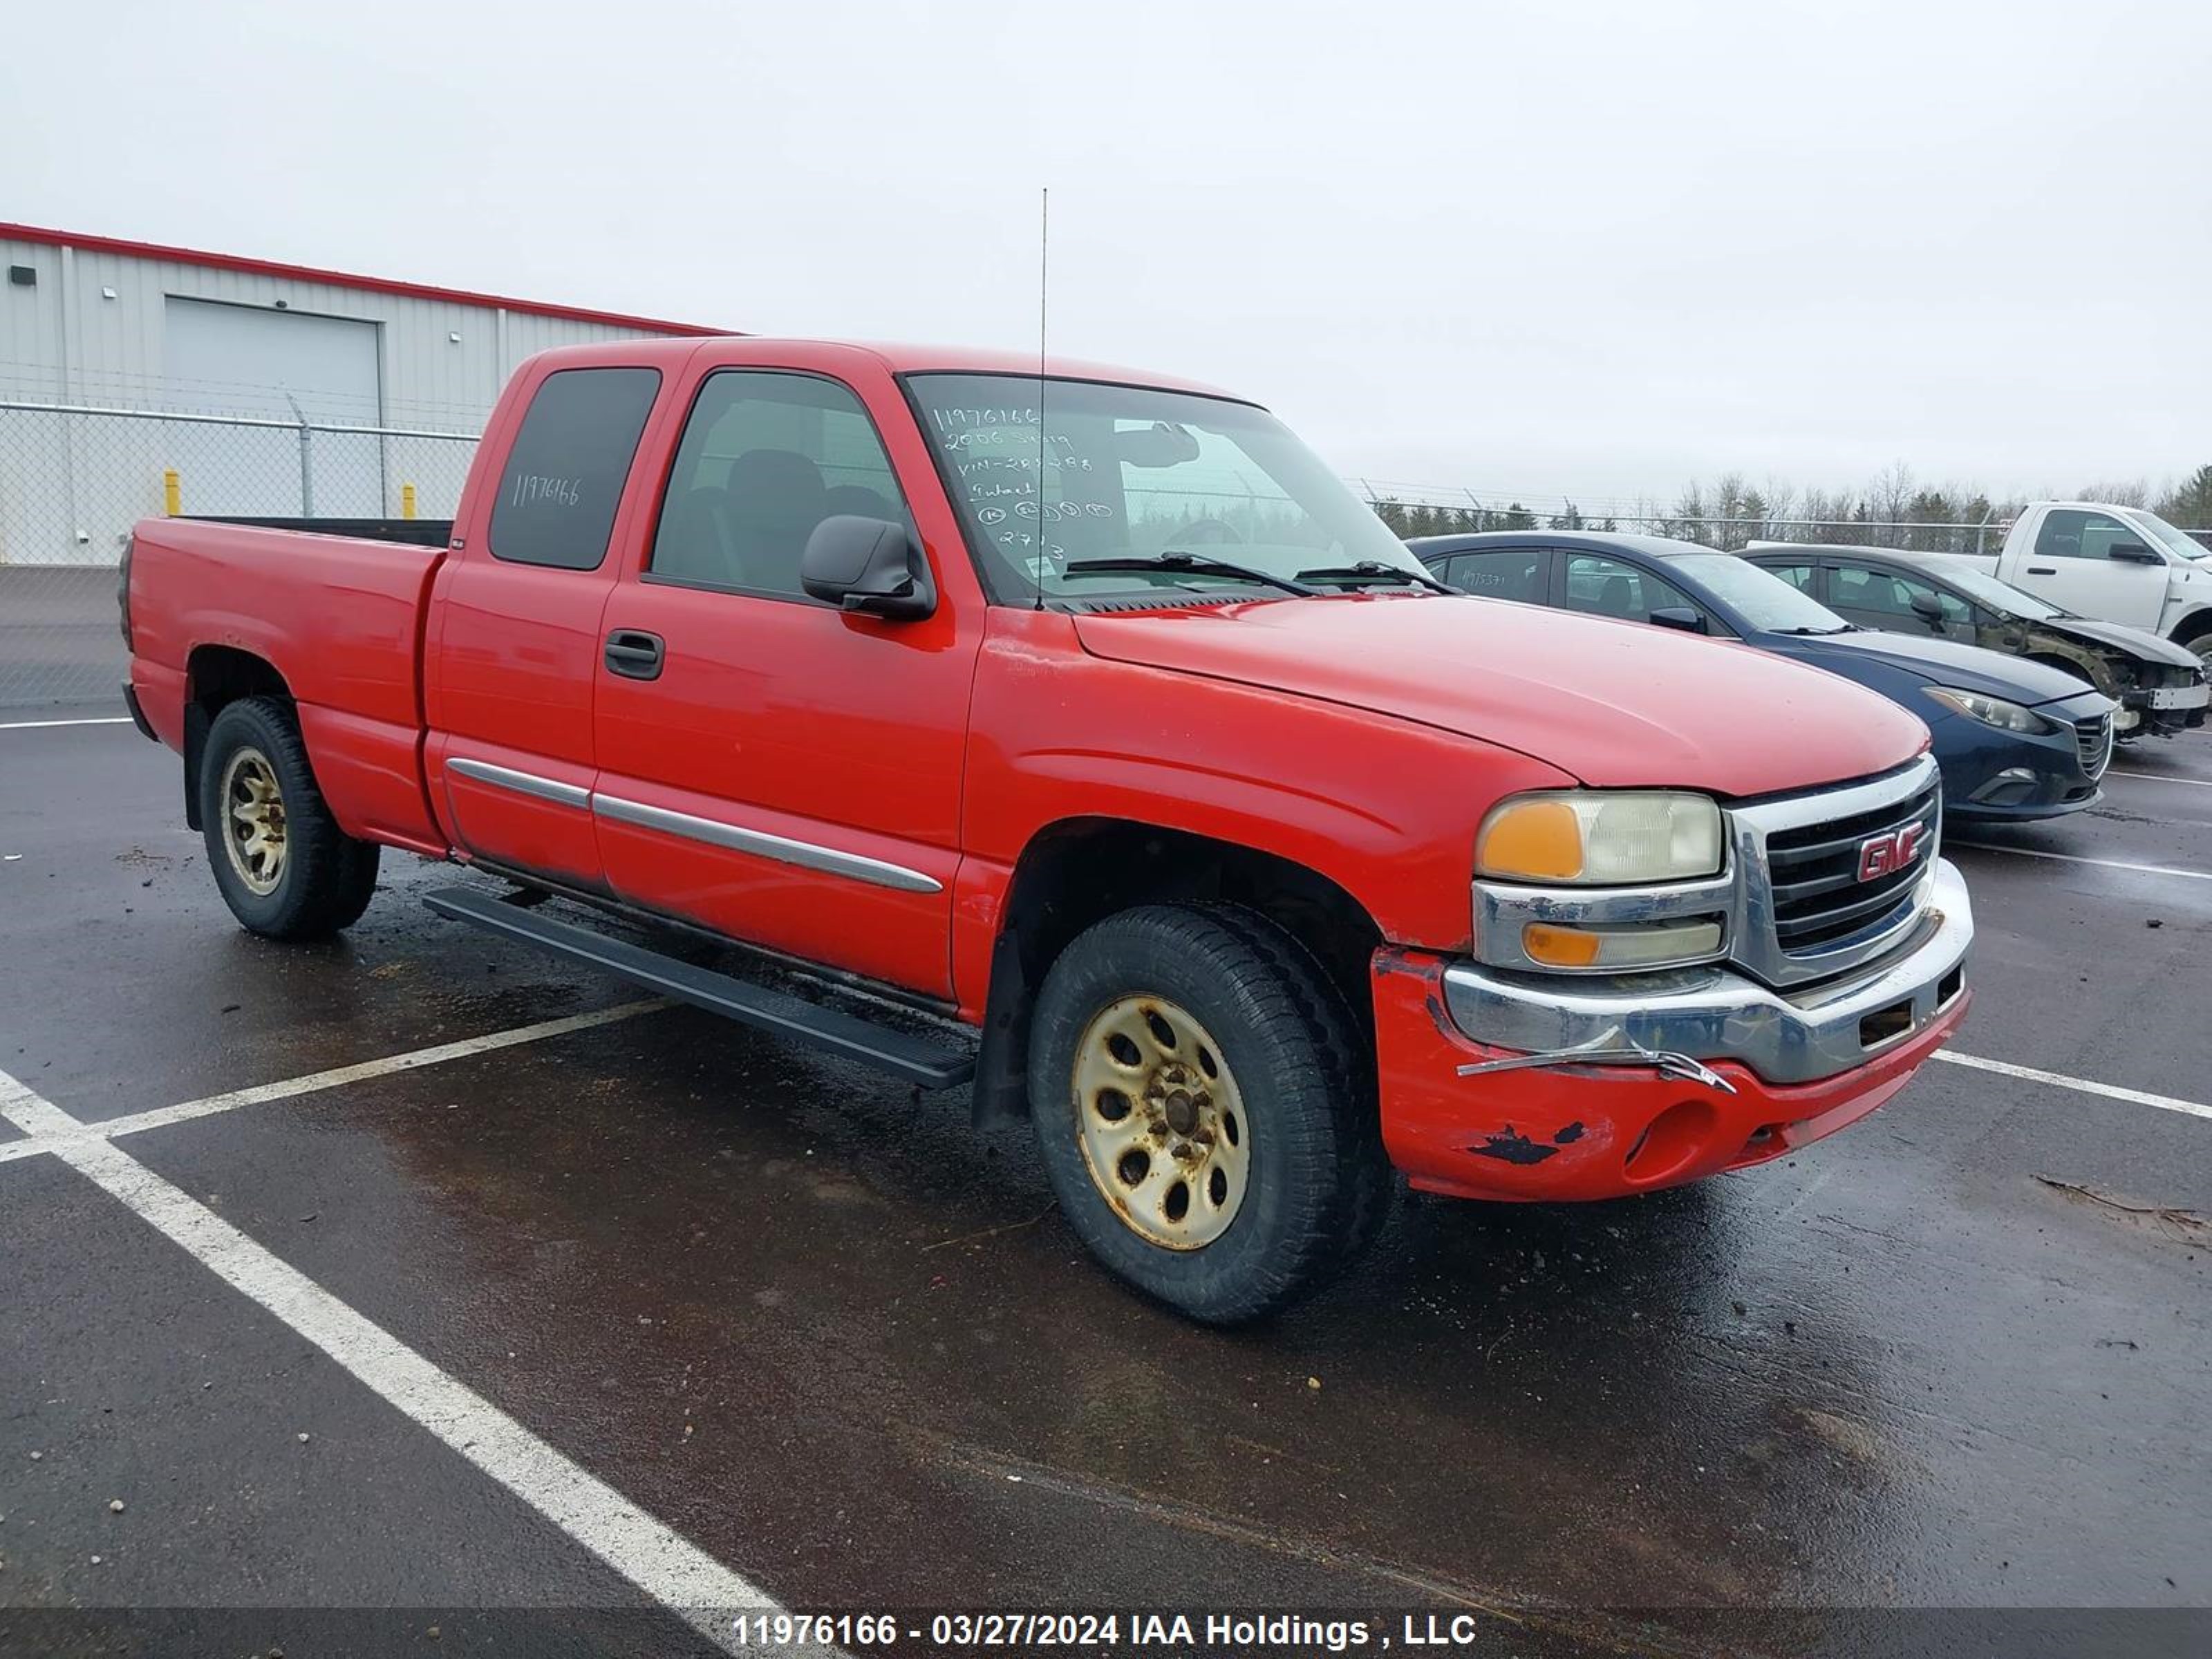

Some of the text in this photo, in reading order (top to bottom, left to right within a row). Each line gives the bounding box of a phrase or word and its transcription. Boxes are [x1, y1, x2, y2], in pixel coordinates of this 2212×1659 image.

[933, 408, 1040, 432] 11976166
[944, 431, 1004, 451] 2006
[512, 474, 582, 507] 11976166
[1858, 821, 1924, 882] GMC
